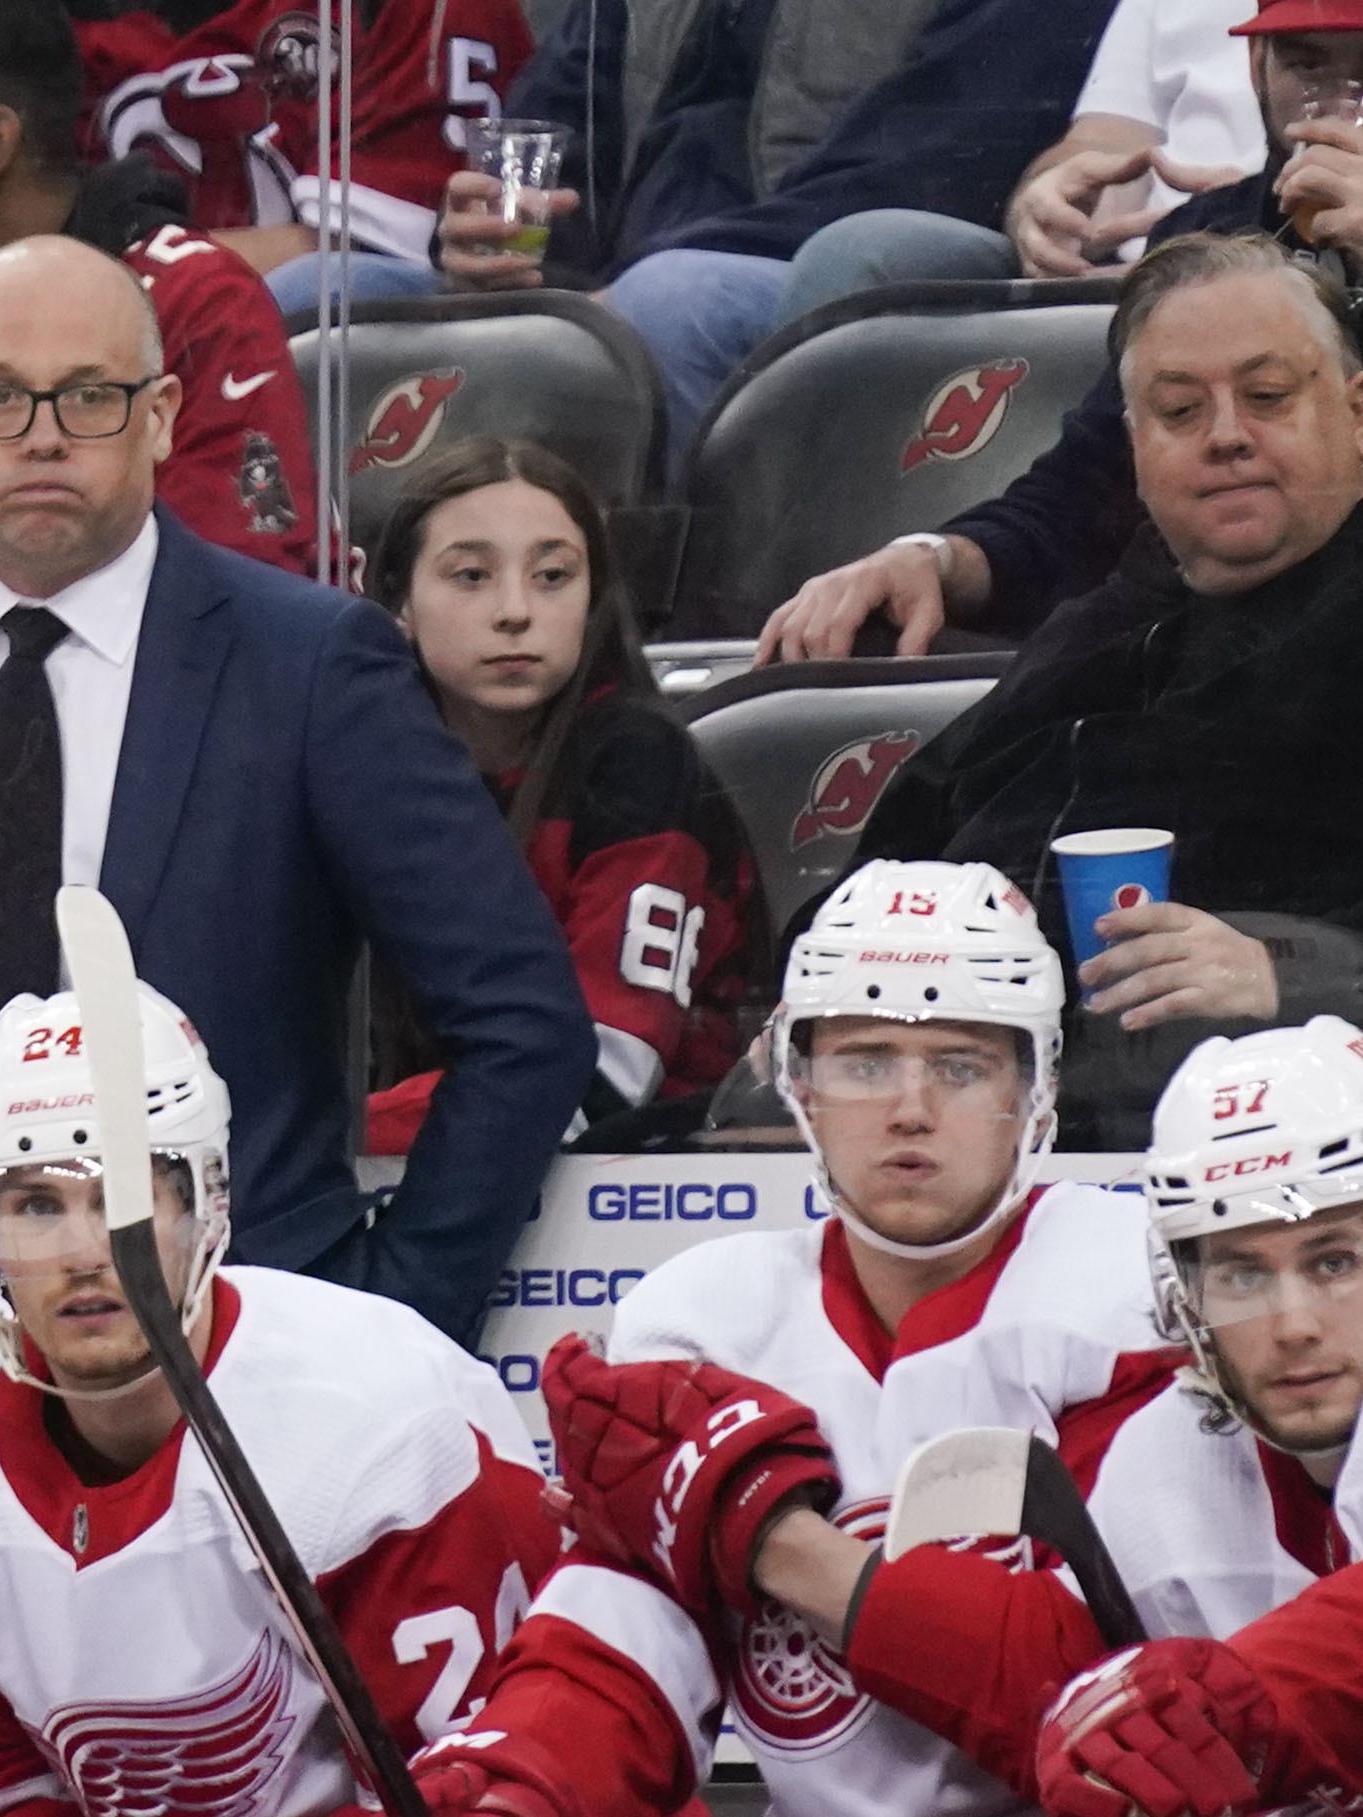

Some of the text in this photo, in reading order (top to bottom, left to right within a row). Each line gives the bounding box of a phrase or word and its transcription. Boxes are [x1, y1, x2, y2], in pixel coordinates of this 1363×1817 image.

[859, 950, 952, 966] BAUER
[22, 1026, 84, 1063] 24
[7, 1093, 97, 1116] BAUER
[1214, 1079, 1273, 1120] 57
[1204, 1151, 1294, 1183] CCM
[588, 1184, 757, 1221] GEICO
